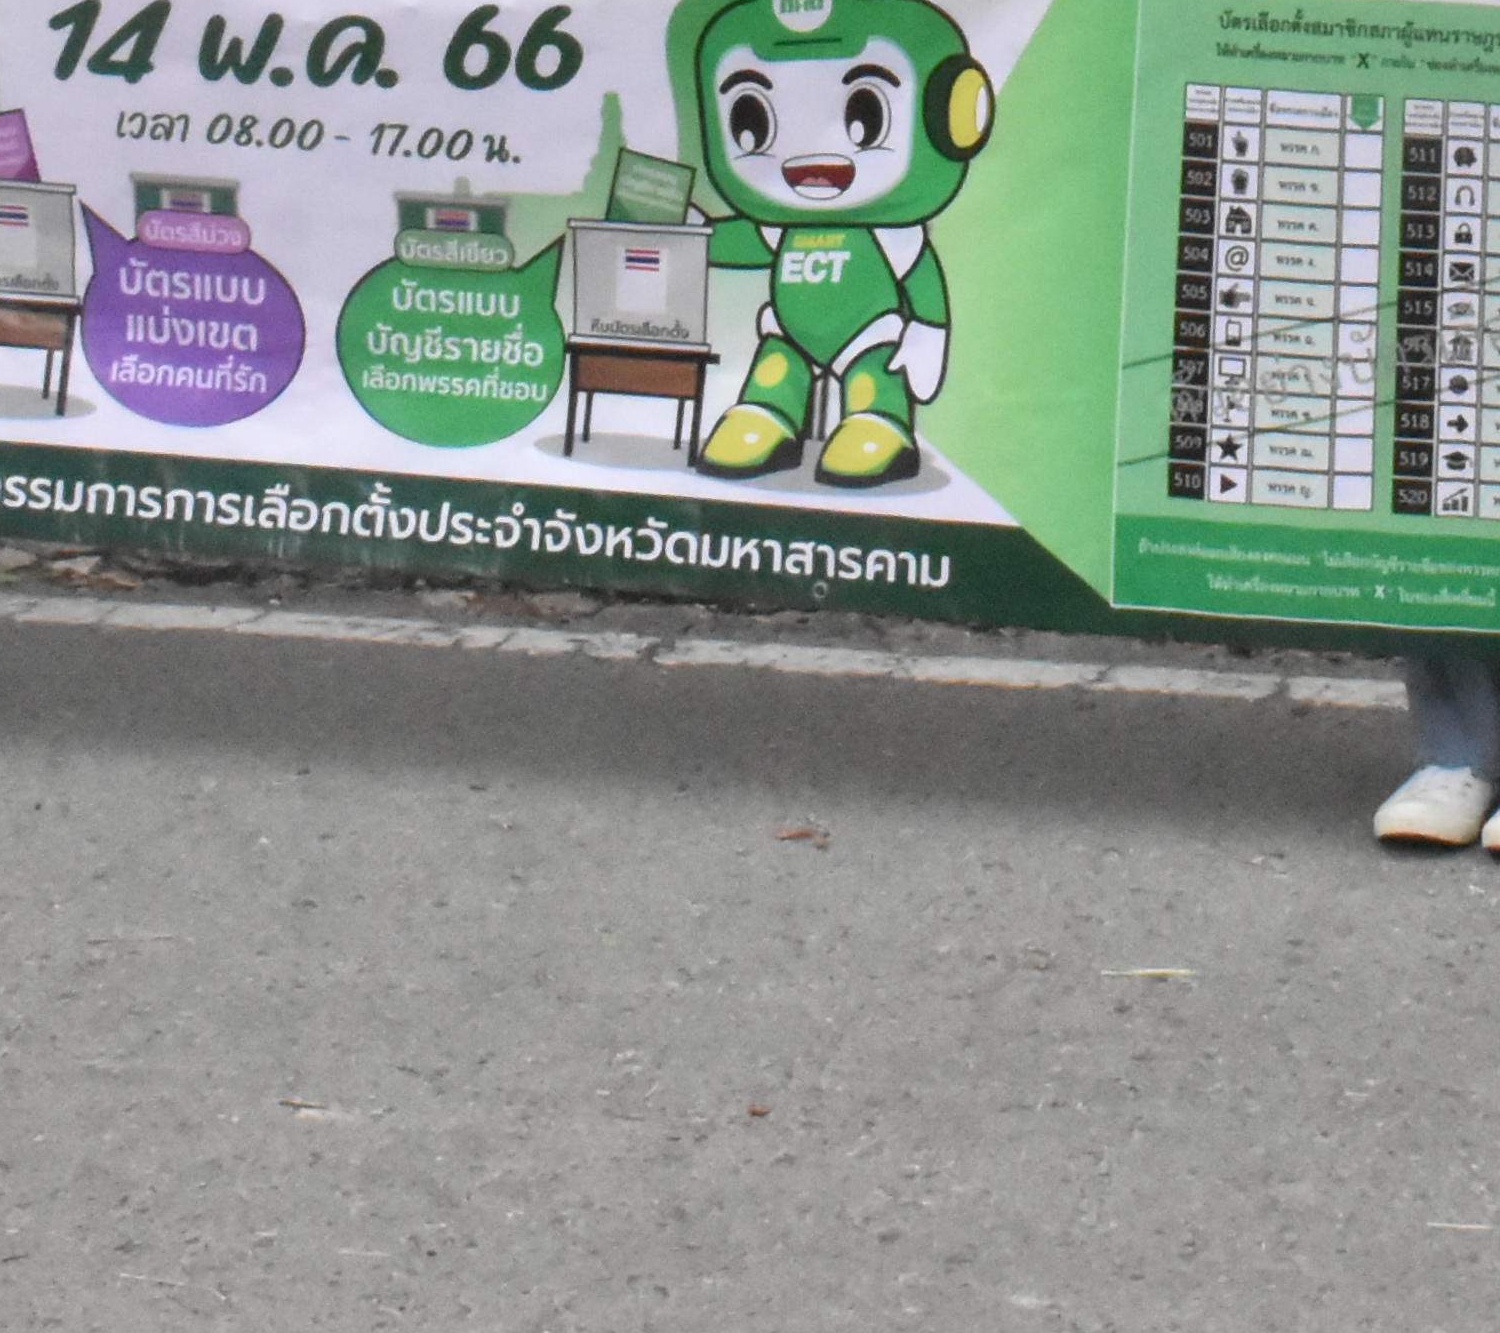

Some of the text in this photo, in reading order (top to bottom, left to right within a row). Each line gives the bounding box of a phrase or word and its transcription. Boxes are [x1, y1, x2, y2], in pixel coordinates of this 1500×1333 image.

[197, 10, 401, 90] พ.ค.
[441, 4, 585, 92] 66
[116, 110, 191, 145] เวลา
[206, 112, 326, 152] 08.00
[369, 122, 475, 163] 17.00
[481, 133, 523, 166] น.
[144, 220, 243, 249] บัตรสีม่วง
[398, 234, 510, 267] บัตรสีเขียว
[779, 250, 851, 285] ECT
[1183, 244, 1210, 263] 504
[119, 256, 267, 305] บัตรแบบ
[391, 277, 521, 318] บัตรแบบ
[1181, 283, 1208, 301] 505
[125, 307, 259, 353] แบ่งเขต
[366, 322, 545, 370] บัญชีรายชื่อ
[110, 355, 268, 395] เลือกคนที่รัก
[361, 361, 548, 403] เลือกพรรคที่ชอบ
[1400, 413, 1431, 431] 518
[1399, 451, 1429, 469] 519
[1174, 472, 1202, 491] 510
[1398, 488, 1429, 506] 520
